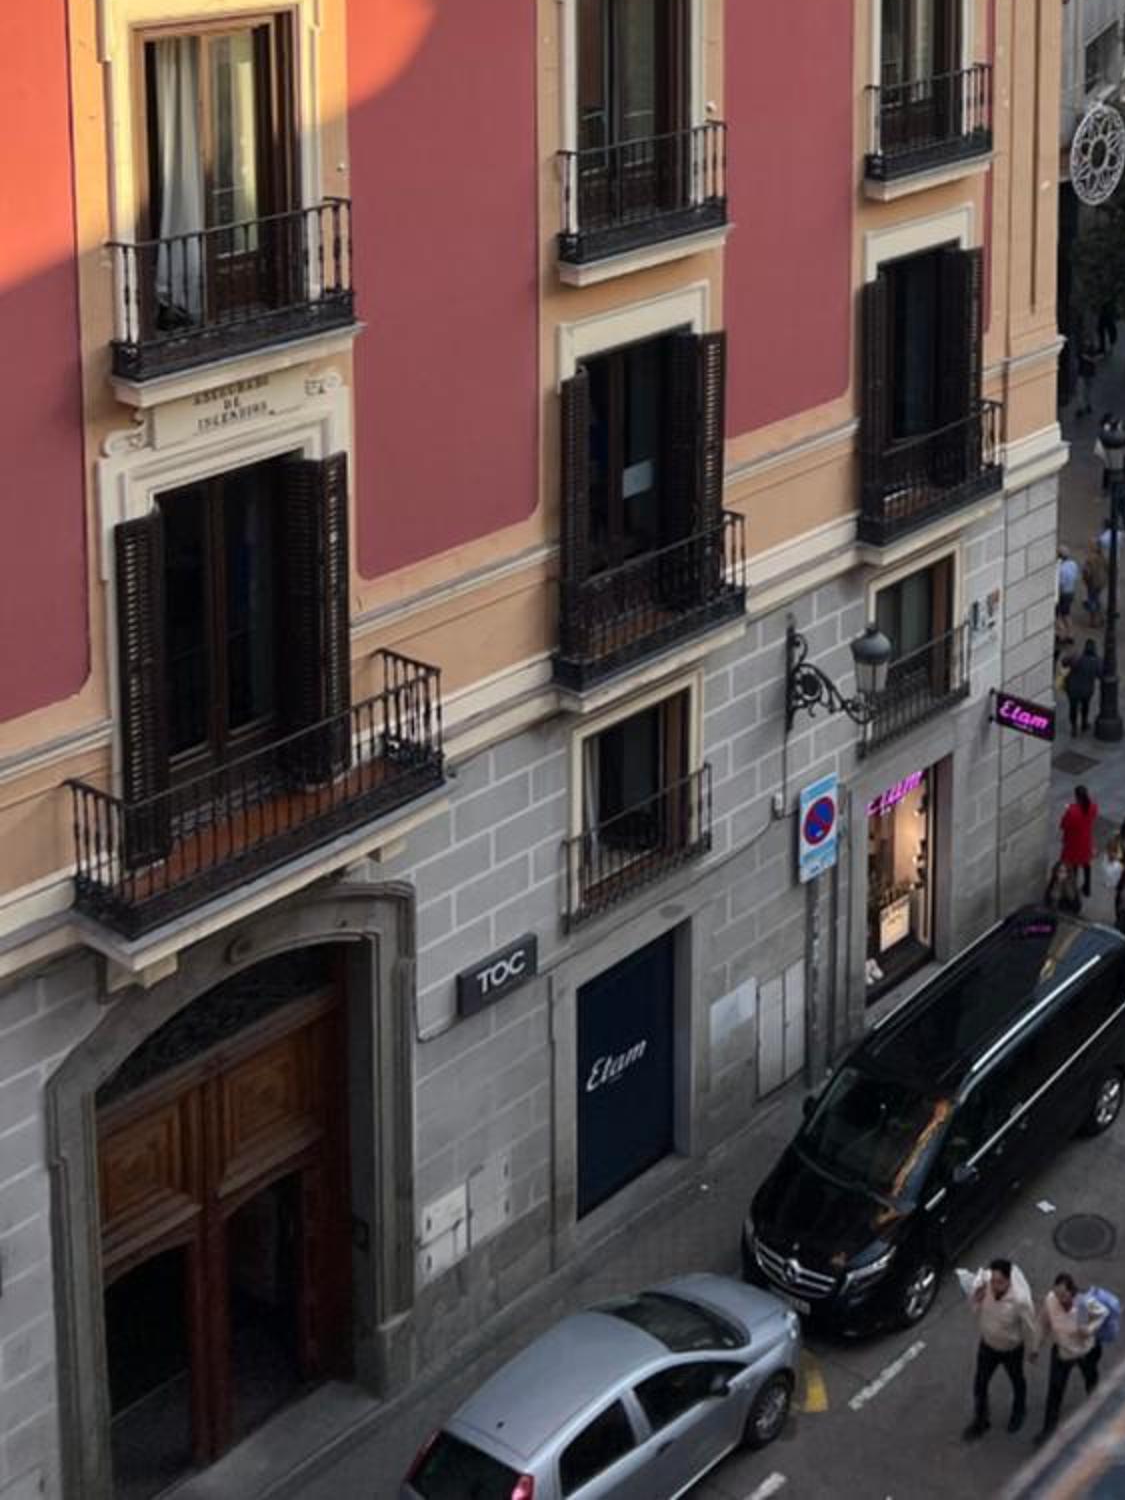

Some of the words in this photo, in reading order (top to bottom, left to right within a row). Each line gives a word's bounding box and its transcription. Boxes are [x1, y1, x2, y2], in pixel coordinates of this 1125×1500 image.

[999, 700, 1049, 729] Etam
[476, 950, 526, 994] TOC
[586, 1039, 647, 1093] Etam
